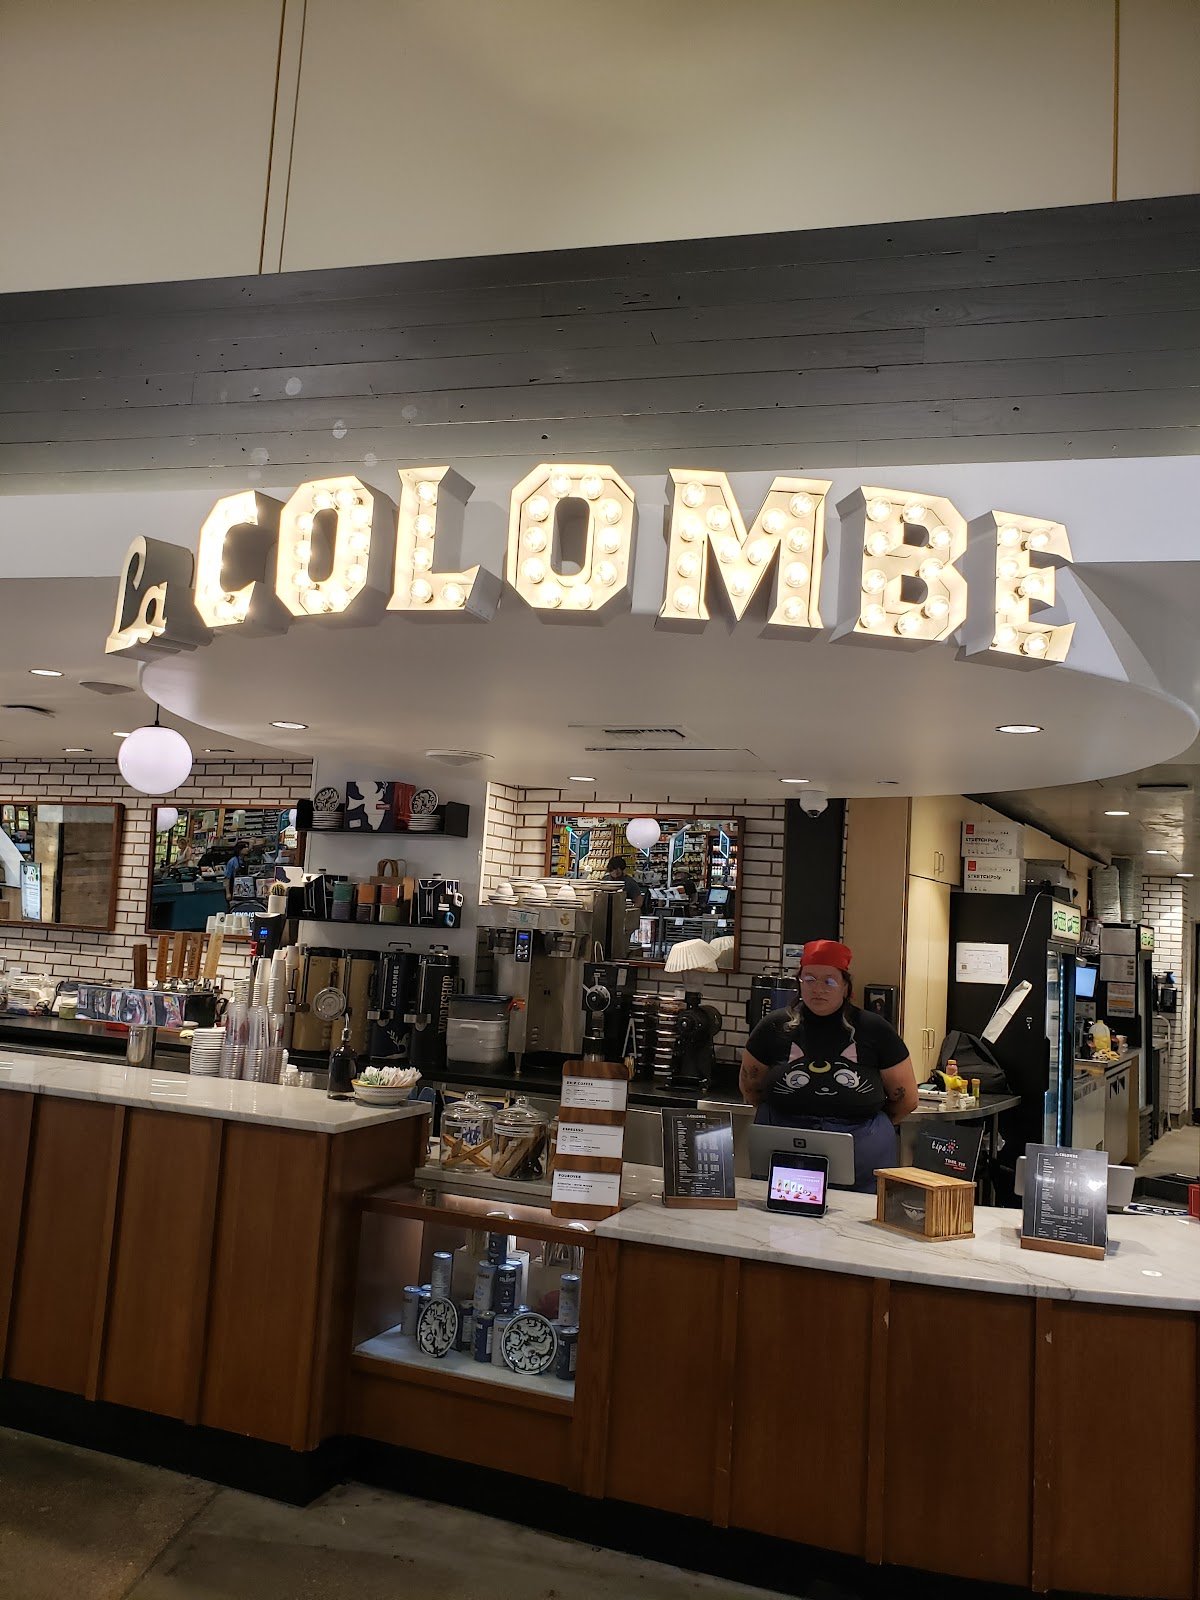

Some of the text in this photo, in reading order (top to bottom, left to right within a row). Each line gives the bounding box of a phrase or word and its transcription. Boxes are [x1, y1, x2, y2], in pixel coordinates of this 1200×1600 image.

[105, 463, 1076, 664] La COLOMBE
[391, 965, 400, 998] COLOMBE
